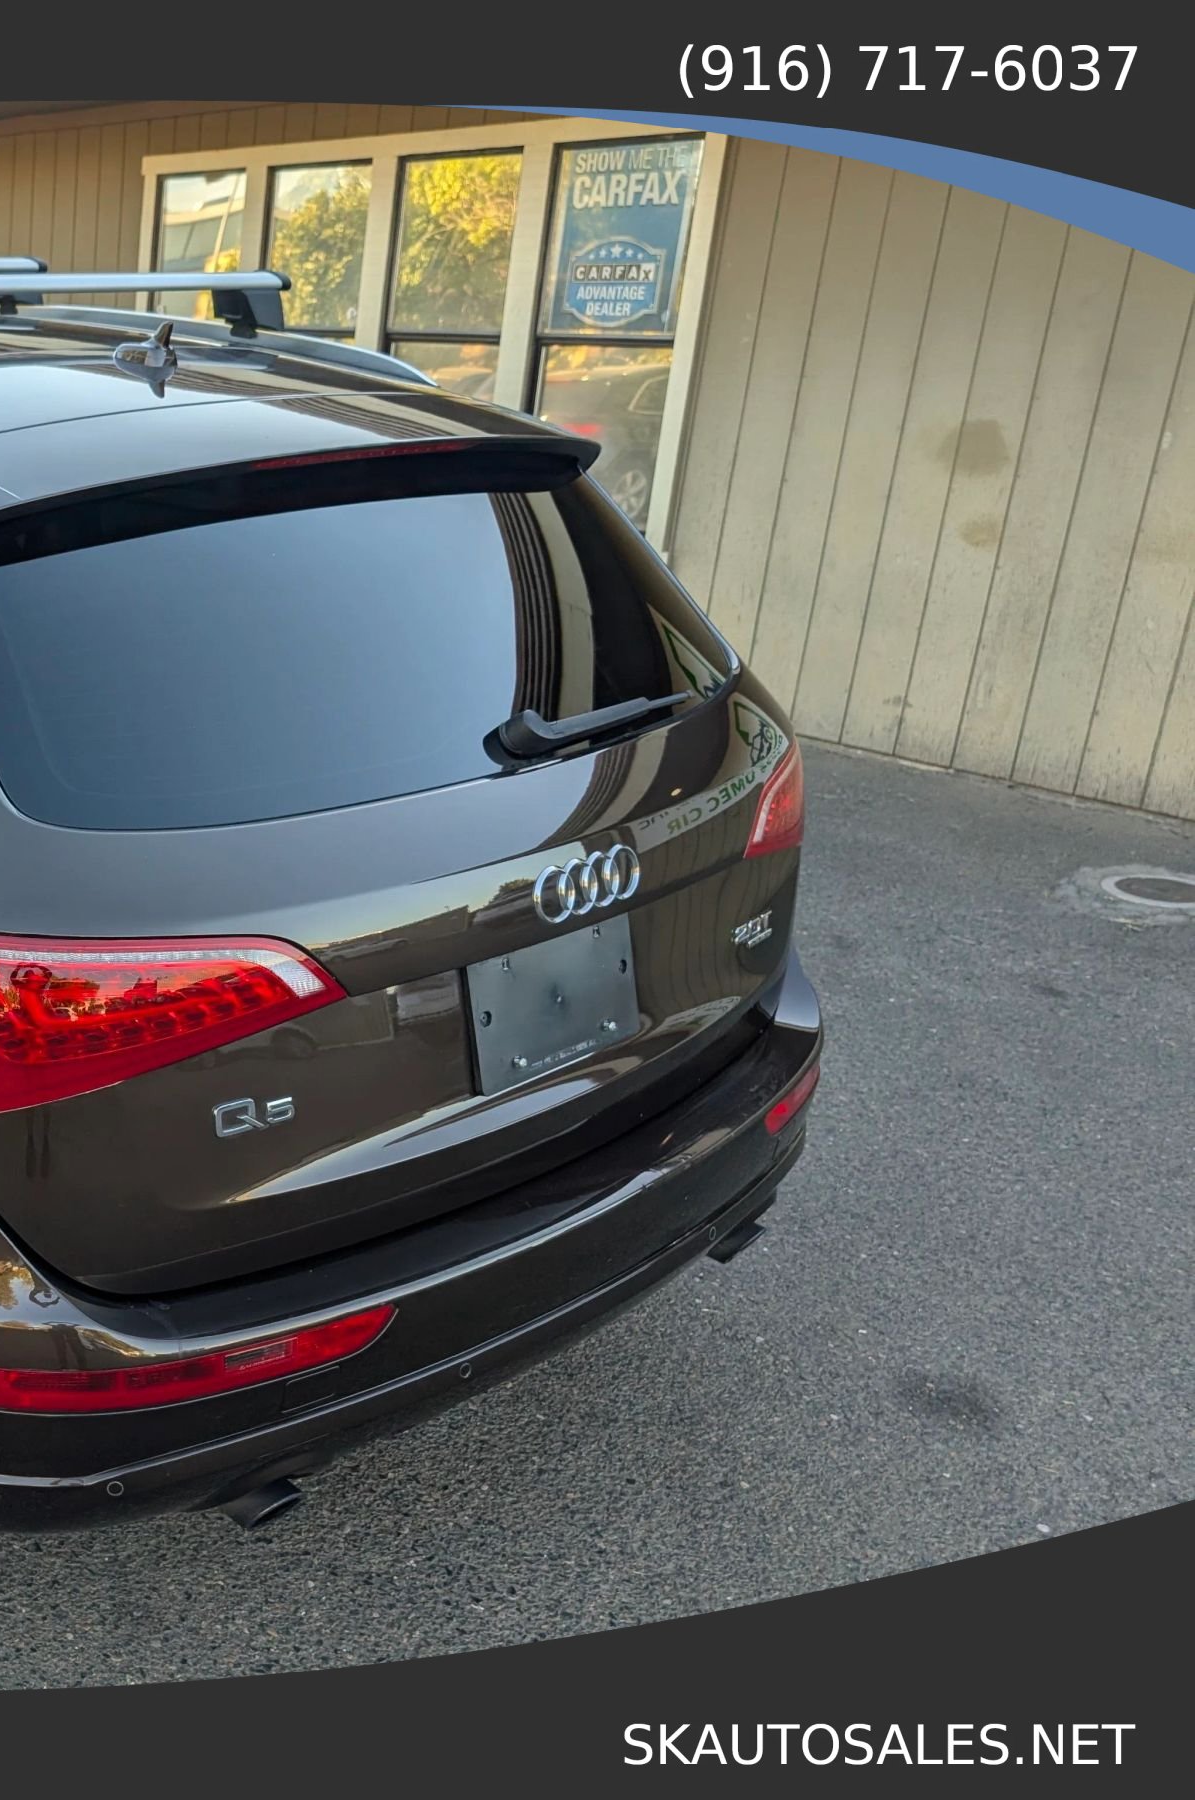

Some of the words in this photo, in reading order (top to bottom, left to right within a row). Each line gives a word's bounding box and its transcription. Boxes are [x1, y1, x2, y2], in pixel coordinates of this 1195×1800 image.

[576, 151, 624, 172] SHOW
[627, 148, 652, 171] ME
[573, 172, 680, 208] CARFAX
[575, 264, 653, 282] CARFAX
[576, 285, 645, 300] ADVANTAGE
[585, 302, 631, 316] DEALER
[213, 1096, 295, 1138] Q5
